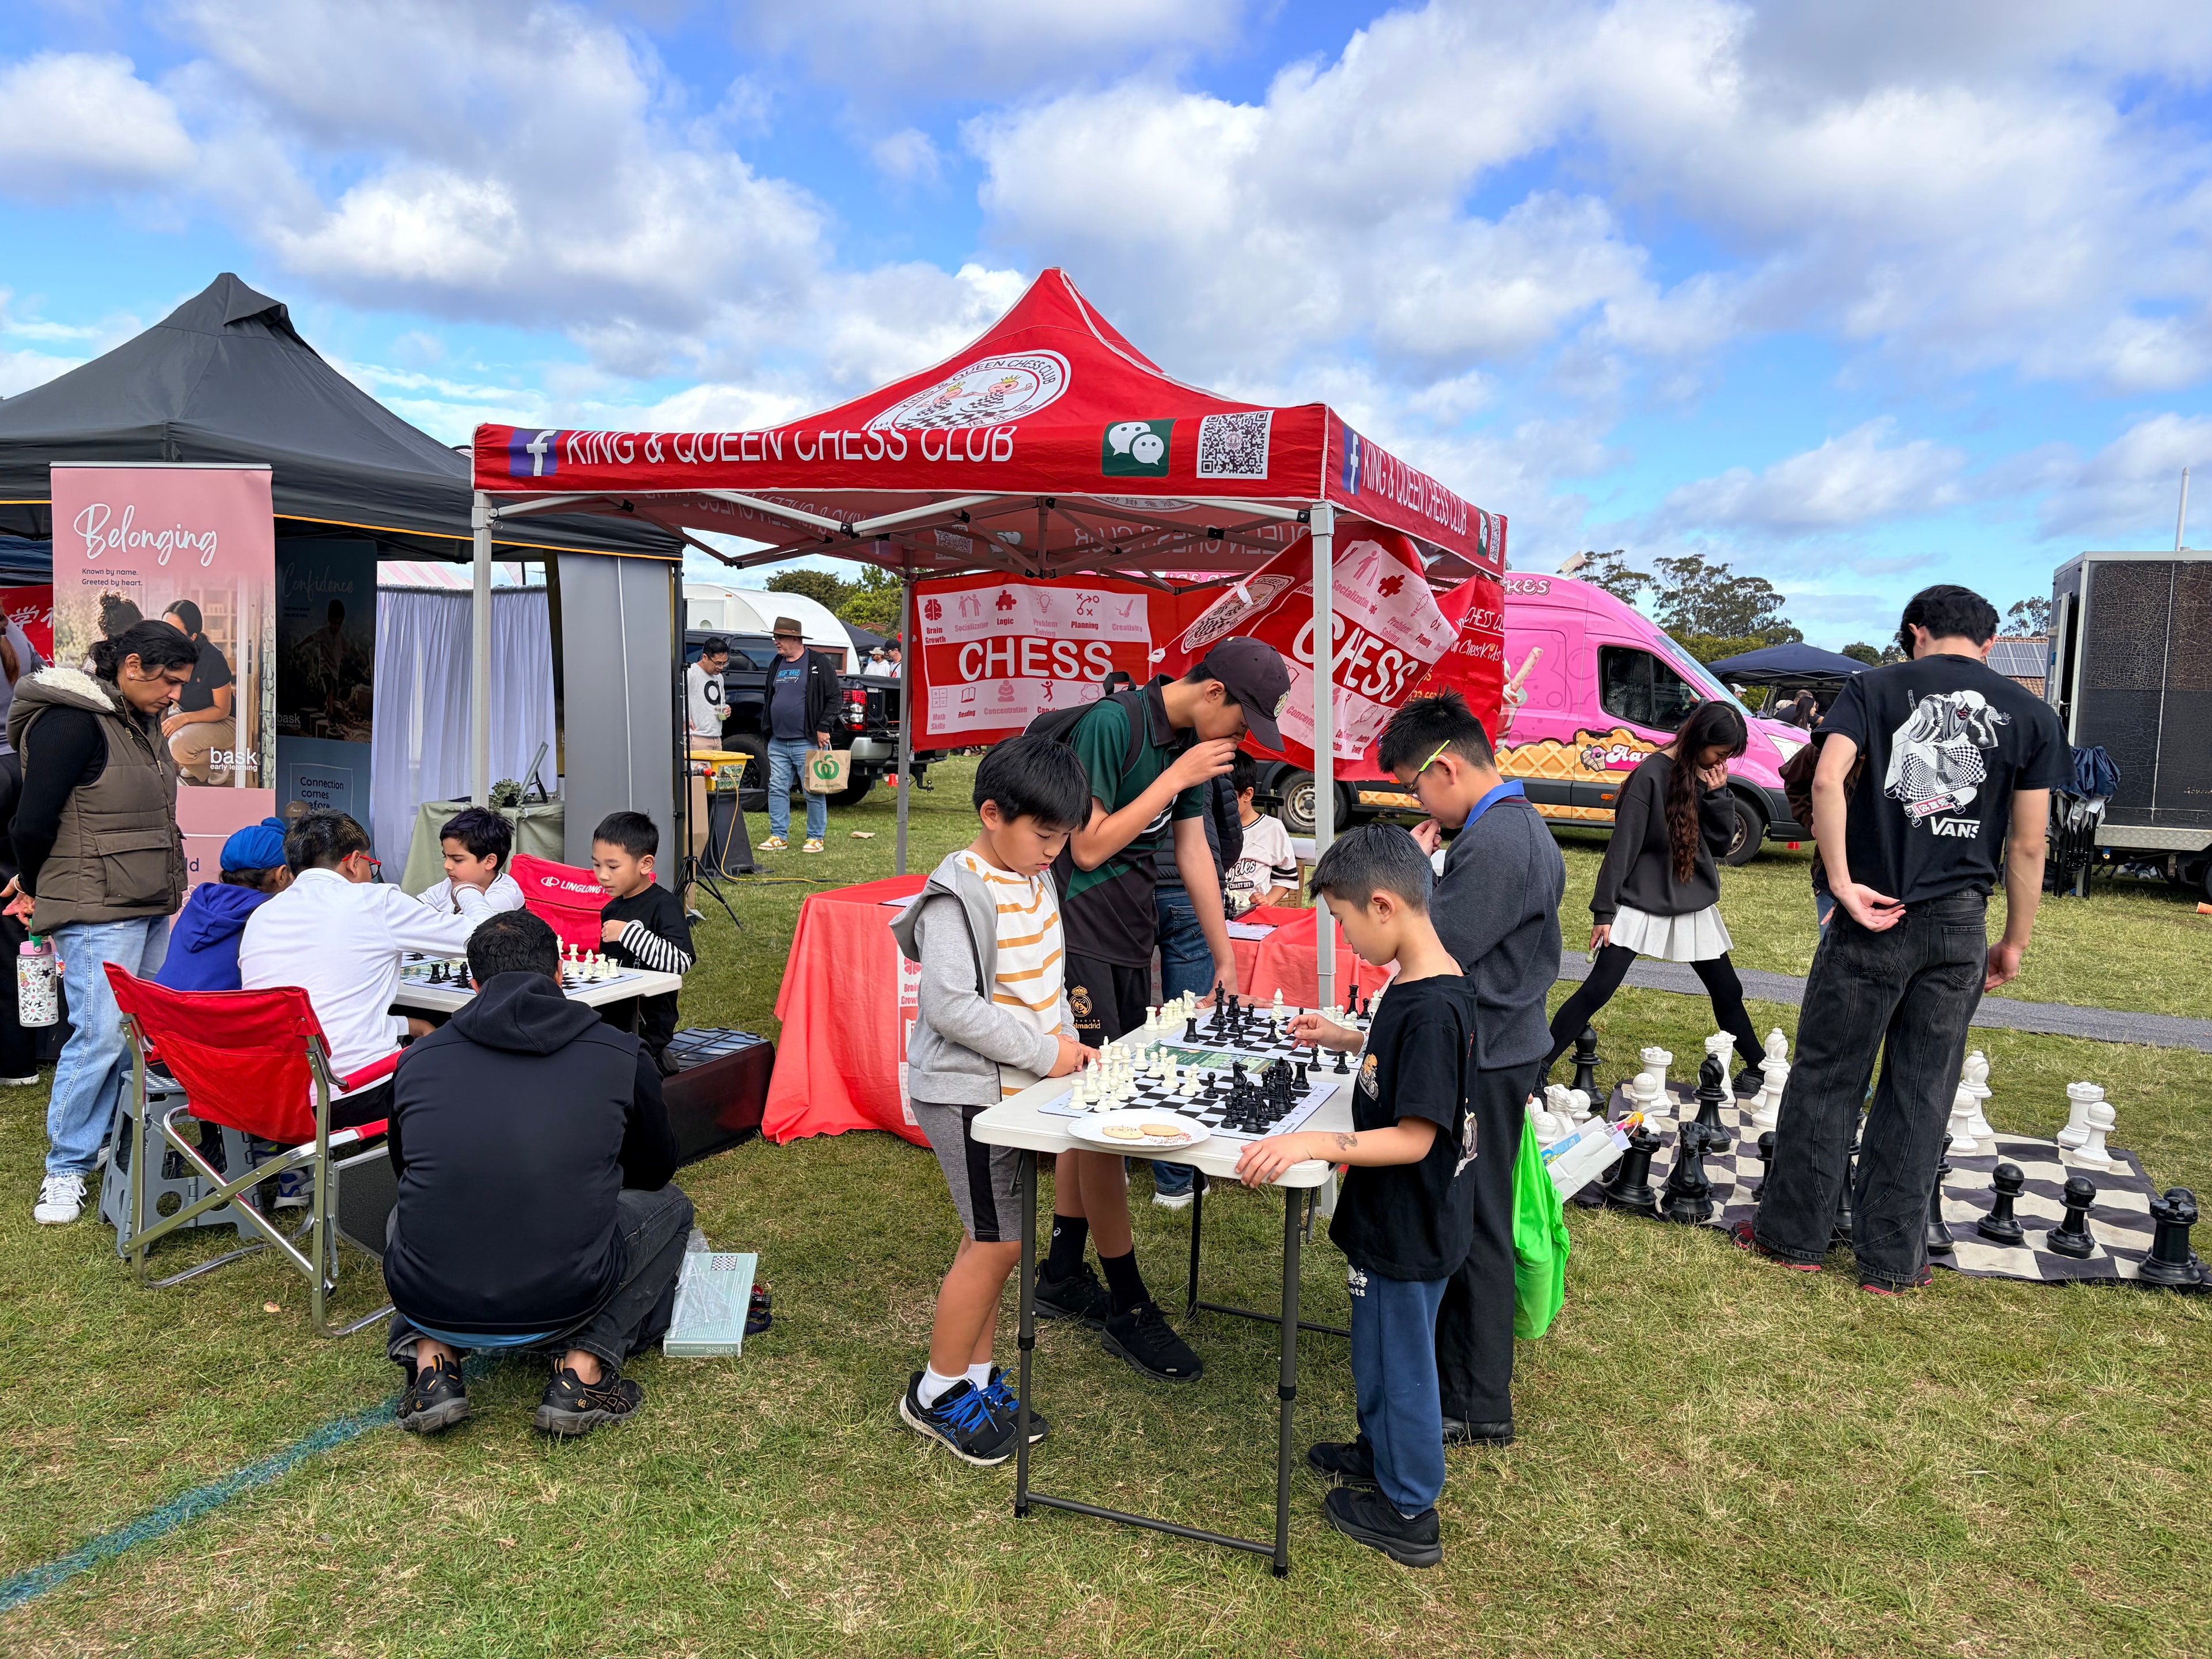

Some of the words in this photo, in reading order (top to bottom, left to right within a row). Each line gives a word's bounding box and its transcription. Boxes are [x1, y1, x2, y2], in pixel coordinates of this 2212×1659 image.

[952, 360, 1006, 382] QUEEN
[1008, 358, 1048, 371] CHESS
[1038, 365, 1057, 385] CLUB
[567, 431, 635, 465] KING
[644, 433, 664, 464] &
[672, 431, 783, 465] QUEEN
[795, 428, 908, 463] CHESS
[921, 426, 1014, 463] CLUB
[1362, 438, 1386, 496] KING
[1388, 454, 1395, 499] &
[1396, 458, 1424, 514] QUEEN
[1425, 475, 1449, 527] CHESS
[1450, 491, 1467, 536] CLUB
[73, 503, 218, 567] Belonging
[106, 569, 115, 577] by
[82, 578, 109, 586] Greeted
[111, 578, 119, 587] by
[282, 562, 355, 601] Confidence
[1504, 578, 1551, 596] KES
[997, 617, 1014, 626] Logic
[1465, 607, 1495, 627] CHESS
[1033, 619, 1058, 628] Problem
[1071, 621, 1099, 630] Planning
[1112, 623, 1143, 633] Creativity
[1387, 616, 1411, 635] Problem
[1035, 627, 1056, 638] Solving
[1380, 627, 1400, 645] Solving
[925, 635, 946, 644] Growth
[959, 637, 1114, 682] CHESS
[984, 706, 1028, 715] Concentration
[277, 712, 301, 724] bask
[931, 722, 946, 730] Skills
[210, 747, 258, 764] bask
[210, 763, 228, 772] early
[229, 764, 258, 772] learning
[300, 777, 344, 790] Connection
[301, 790, 329, 800] comes
[1930, 816, 1981, 839] VANS
[560, 880, 603, 894] LINGLONG
[1350, 1287, 1365, 1297] ots
[706, 1346, 733, 1354] CHESS
[577, 1398, 587, 1409] GEL
